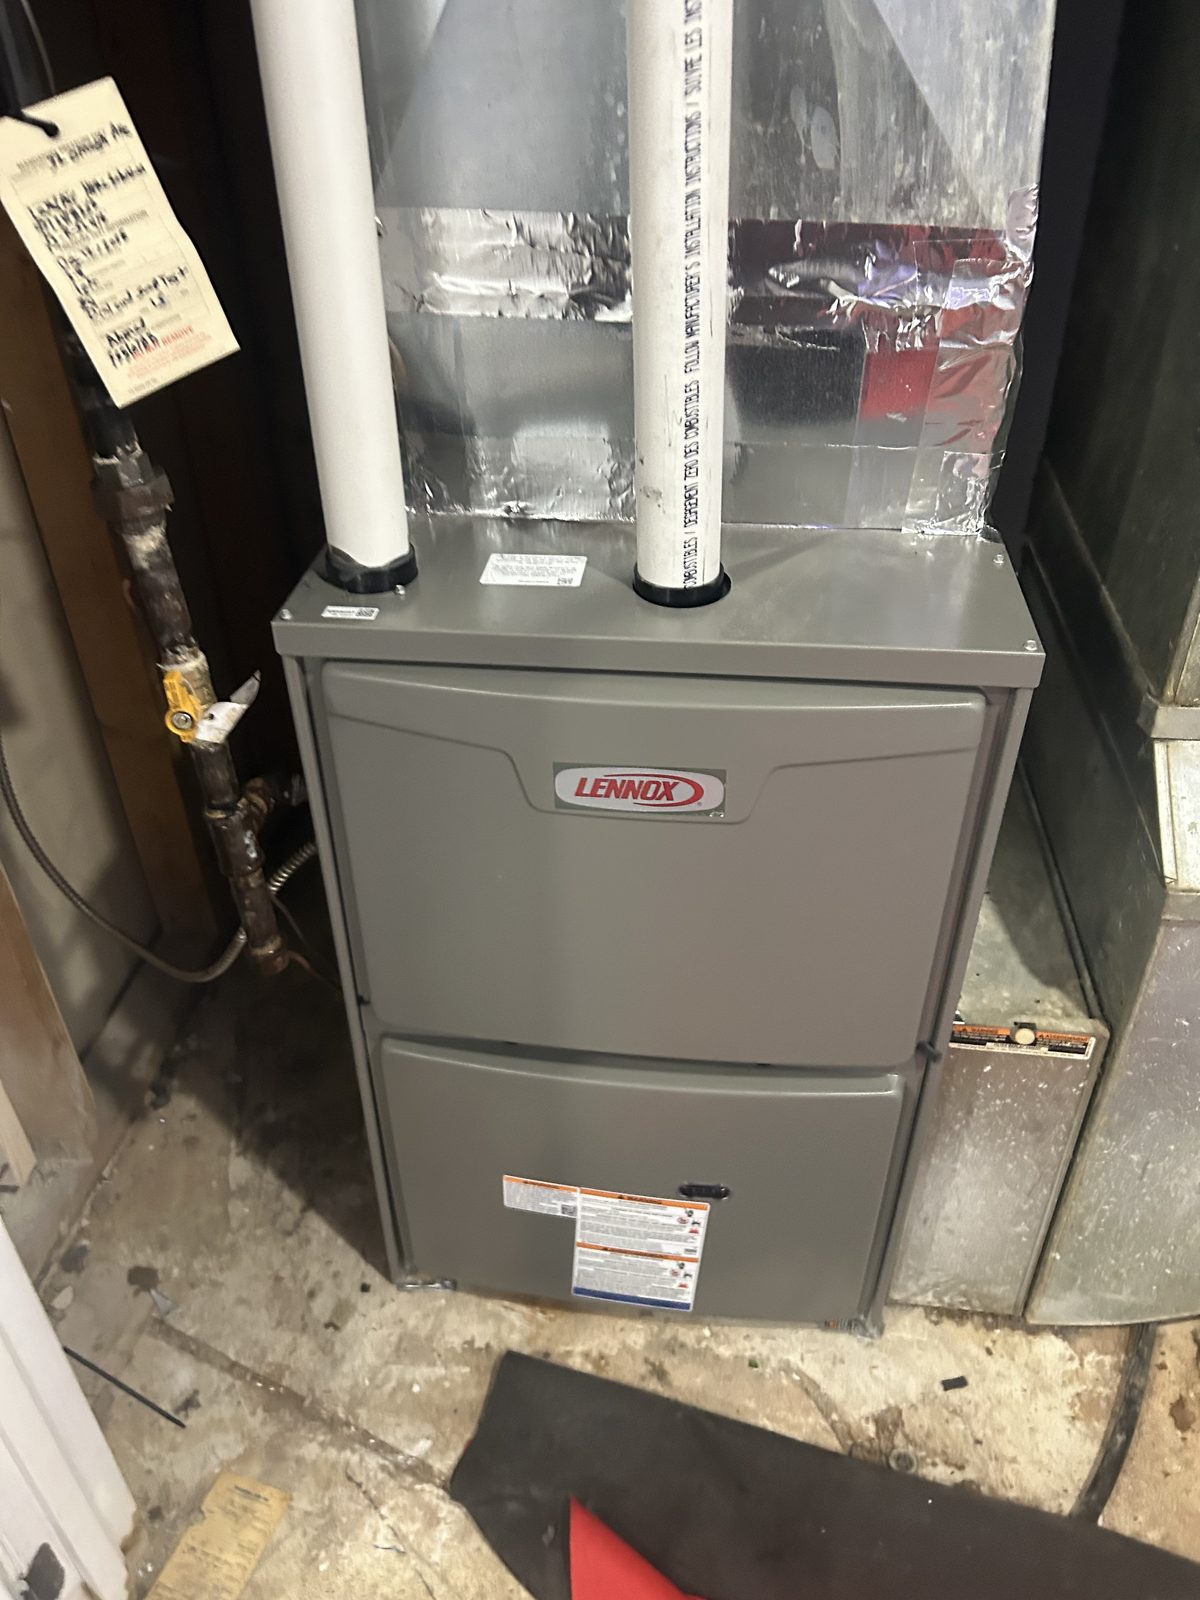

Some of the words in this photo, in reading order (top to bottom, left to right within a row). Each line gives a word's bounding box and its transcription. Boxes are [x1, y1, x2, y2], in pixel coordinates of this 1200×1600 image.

[684, 27, 703, 50] LES
[684, 53, 703, 97] SUIVRE
[684, 110, 702, 187] INSTRUCTIONS
[684, 188, 702, 260] INSTALLATION
[684, 339, 701, 374] FOLLOW
[683, 379, 700, 440] COMBUSTIBLES
[684, 441, 700, 458] DES
[684, 459, 699, 481] ZERO
[574, 777, 680, 802] LENNOX
